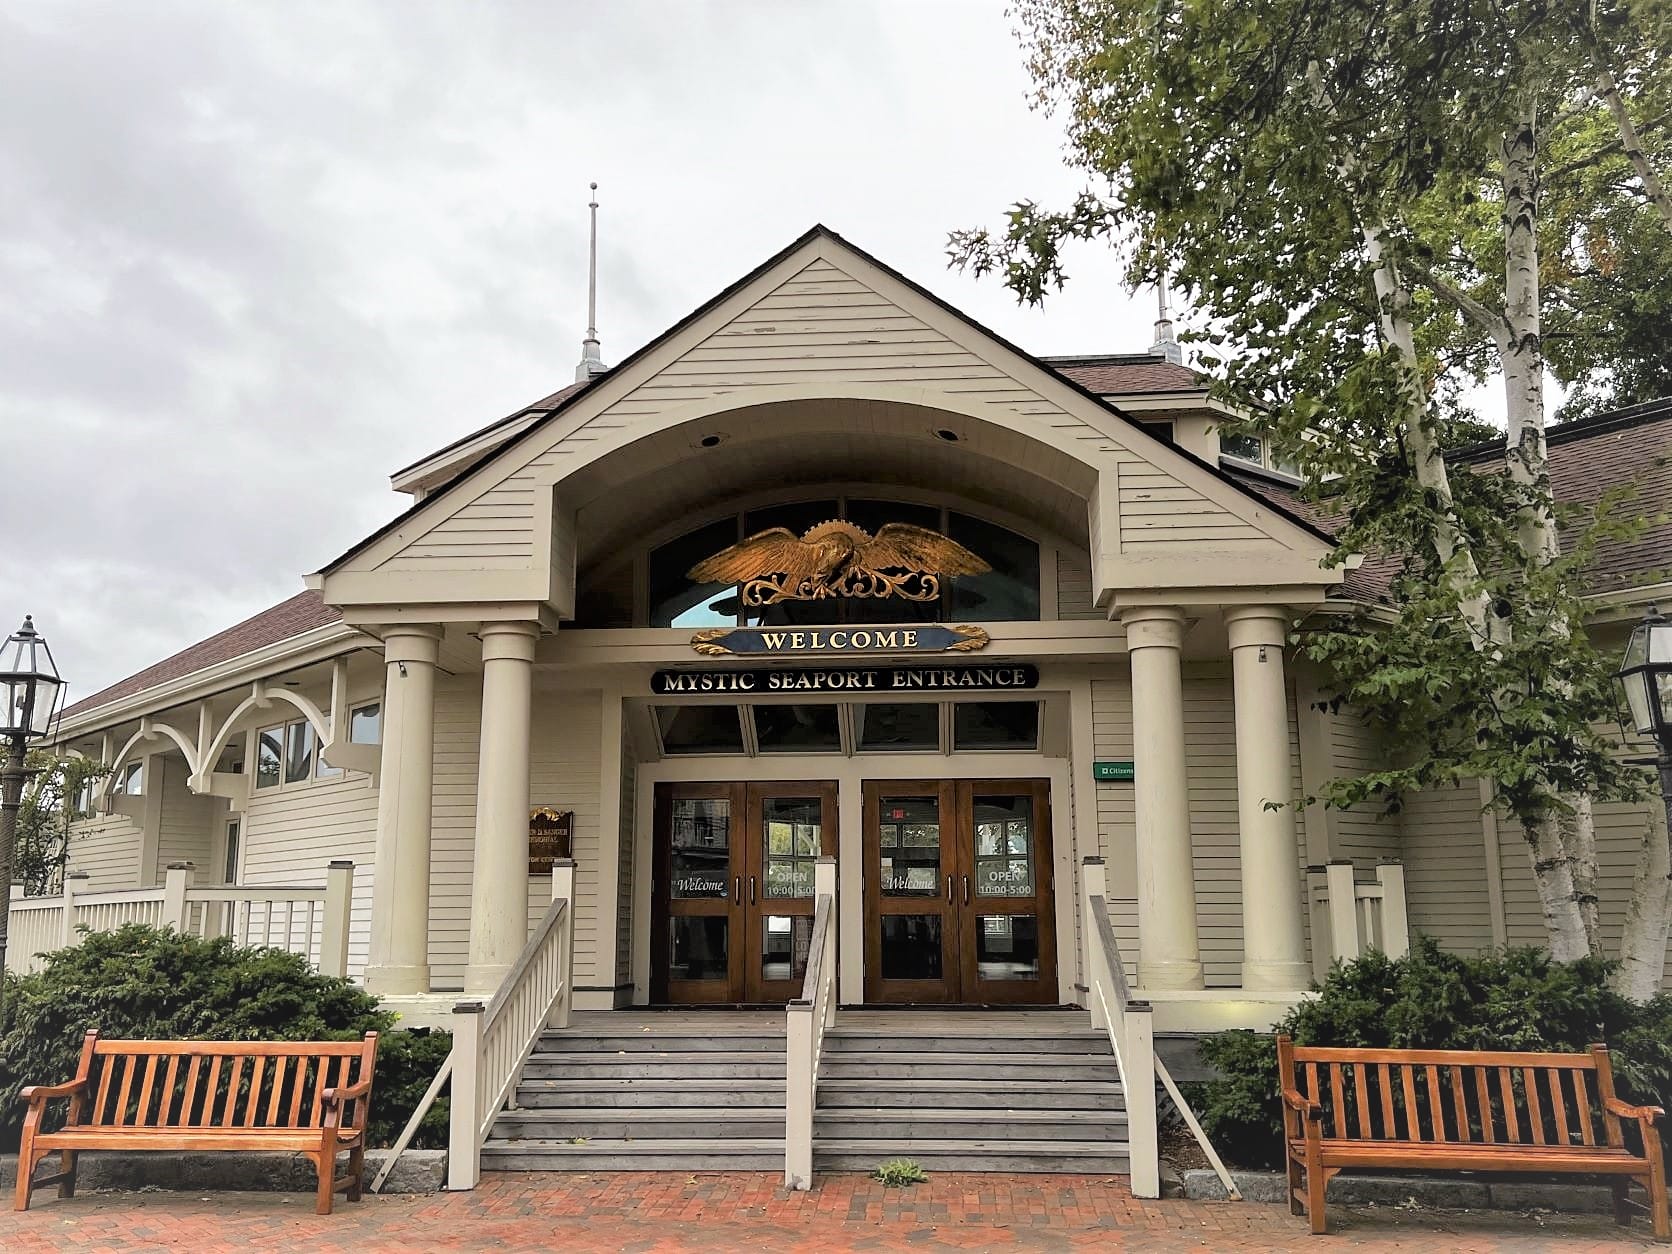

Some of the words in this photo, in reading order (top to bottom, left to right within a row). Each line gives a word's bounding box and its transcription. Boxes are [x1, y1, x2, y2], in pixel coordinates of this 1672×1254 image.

[761, 631, 917, 650] WELCOME
[664, 673, 755, 691] MYSTIC
[768, 671, 877, 689] SEAPORT
[892, 669, 1026, 687] ENTRANCE
[777, 872, 808, 882] OPEN
[887, 875, 933, 890] Welcome
[989, 871, 1020, 881] OPEN
[677, 877, 724, 891] Welcome
